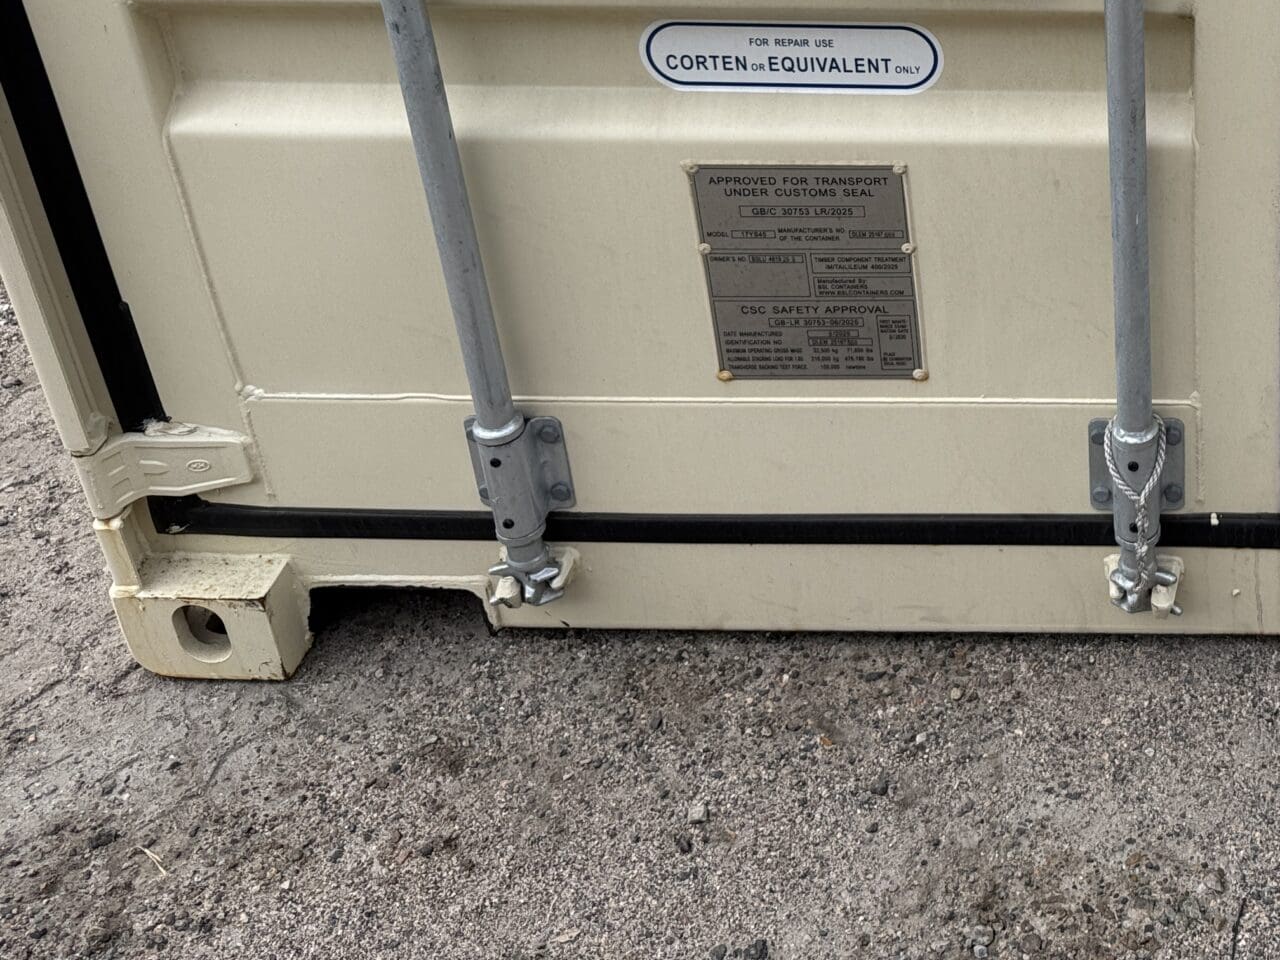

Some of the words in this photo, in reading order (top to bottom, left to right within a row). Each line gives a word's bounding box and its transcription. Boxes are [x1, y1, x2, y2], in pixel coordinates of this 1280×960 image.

[749, 38, 769, 47] FOR
[775, 38, 810, 48] REPAIR
[815, 38, 834, 48] USE
[666, 54, 748, 71] CORTEN
[751, 62, 765, 71] OR
[768, 56, 891, 74] EQUIVALENT
[895, 65, 920, 75] ONLY
[708, 176, 777, 186] APPROVED
[783, 176, 809, 186] FOR
[814, 176, 888, 186] TRANSPORT
[724, 188, 768, 197] UNDER
[775, 188, 837, 197] CUSTOMS
[843, 188, 875, 198] SEAL
[752, 208, 777, 216] GB/C
[782, 208, 810, 216] 30753
[814, 208, 854, 216] LR/2025
[741, 305, 767, 314] CSC
[772, 305, 820, 314] SAFETY
[825, 305, 889, 314] APPROVAL
